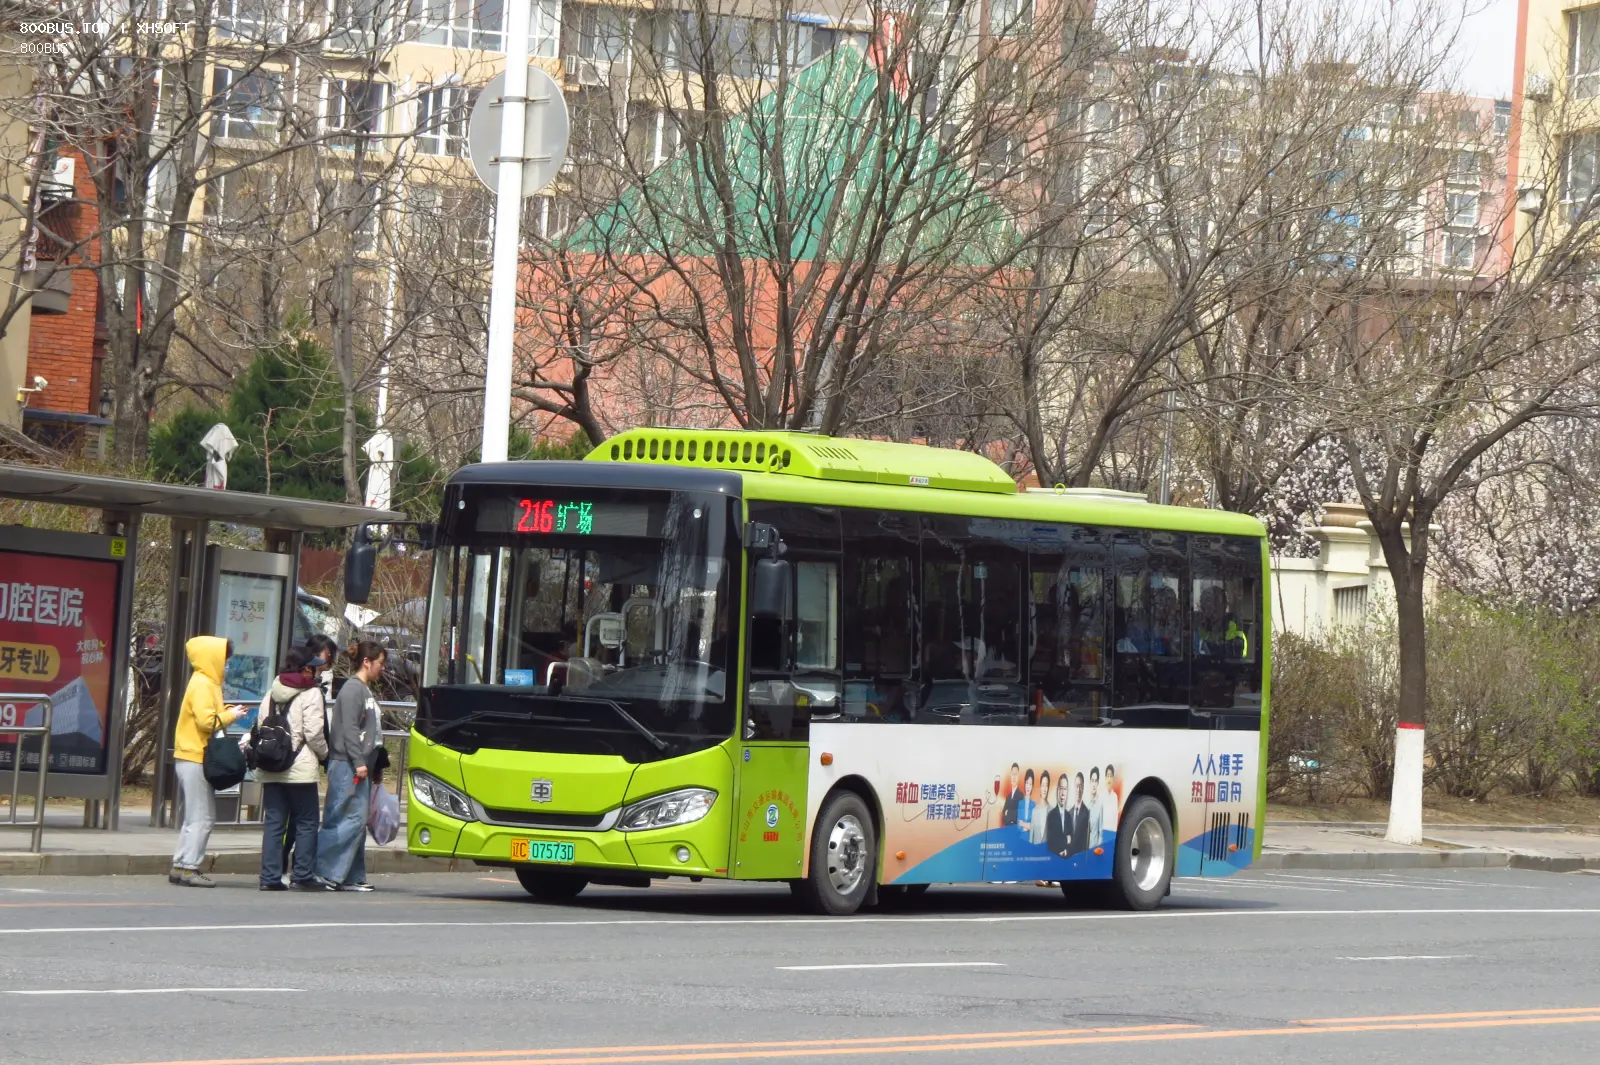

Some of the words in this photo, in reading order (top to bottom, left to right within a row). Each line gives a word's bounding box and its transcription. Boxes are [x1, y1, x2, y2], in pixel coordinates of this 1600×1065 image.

[517, 499, 554, 533] 216
[556, 501, 593, 534] 广场
[0, 703, 17, 728] 9
[1192, 753, 1244, 776] 人人携手
[1191, 780, 1242, 803] 热血同舟
